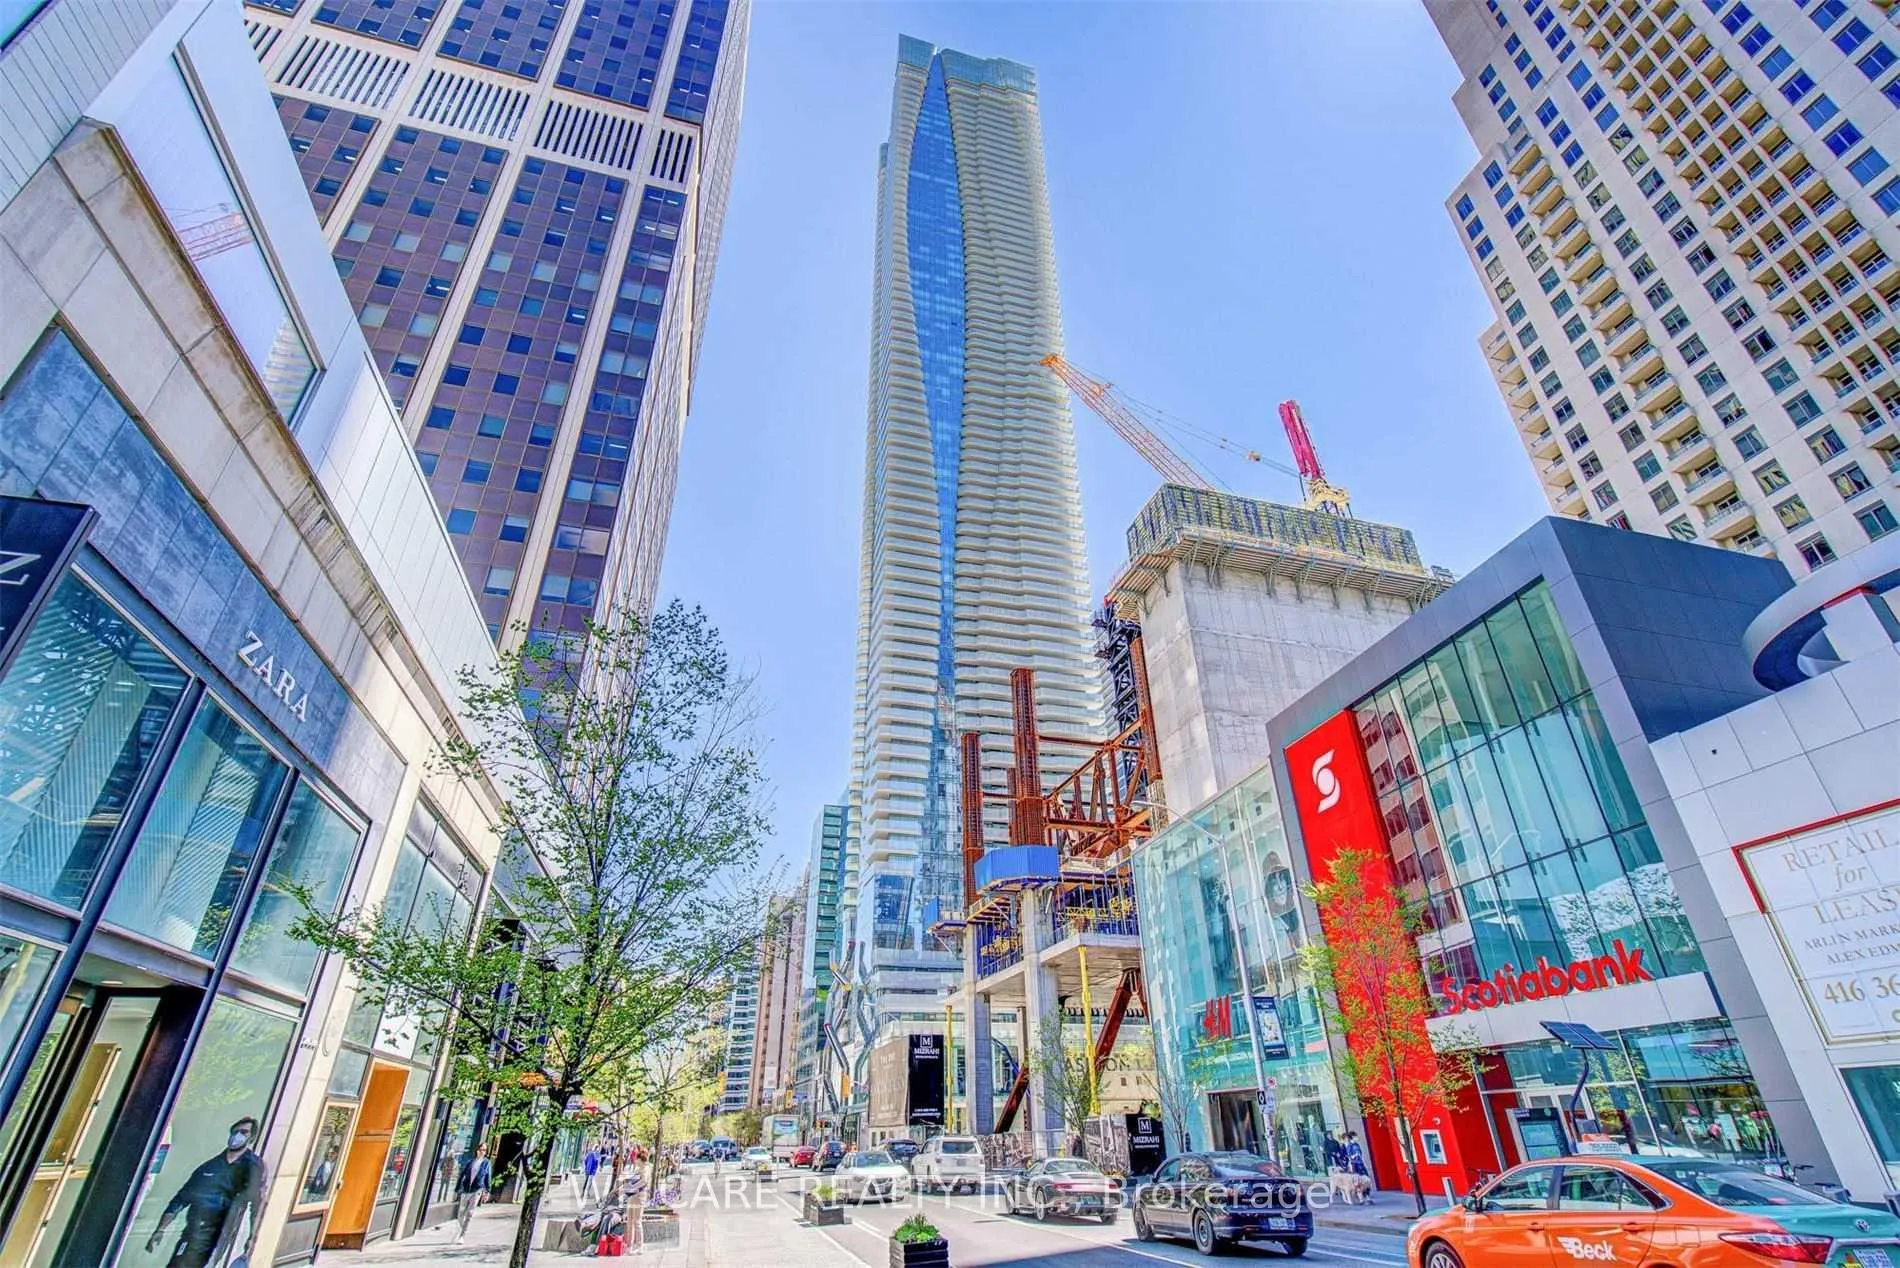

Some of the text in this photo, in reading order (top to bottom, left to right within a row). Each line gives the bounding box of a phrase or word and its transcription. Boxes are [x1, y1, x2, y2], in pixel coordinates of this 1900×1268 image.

[238, 630, 308, 722] ZARA
[1782, 829, 1900, 872] RETAIL
[1834, 863, 1867, 892] for
[1813, 887, 1900, 925] LEAS
[1804, 933, 1851, 950] ARLIN
[1827, 949, 1866, 965] ALEX
[1441, 939, 1655, 1015] Scotiabank
[1825, 978, 1865, 1004] 416
[1565, 1239, 1617, 1261] Beck
